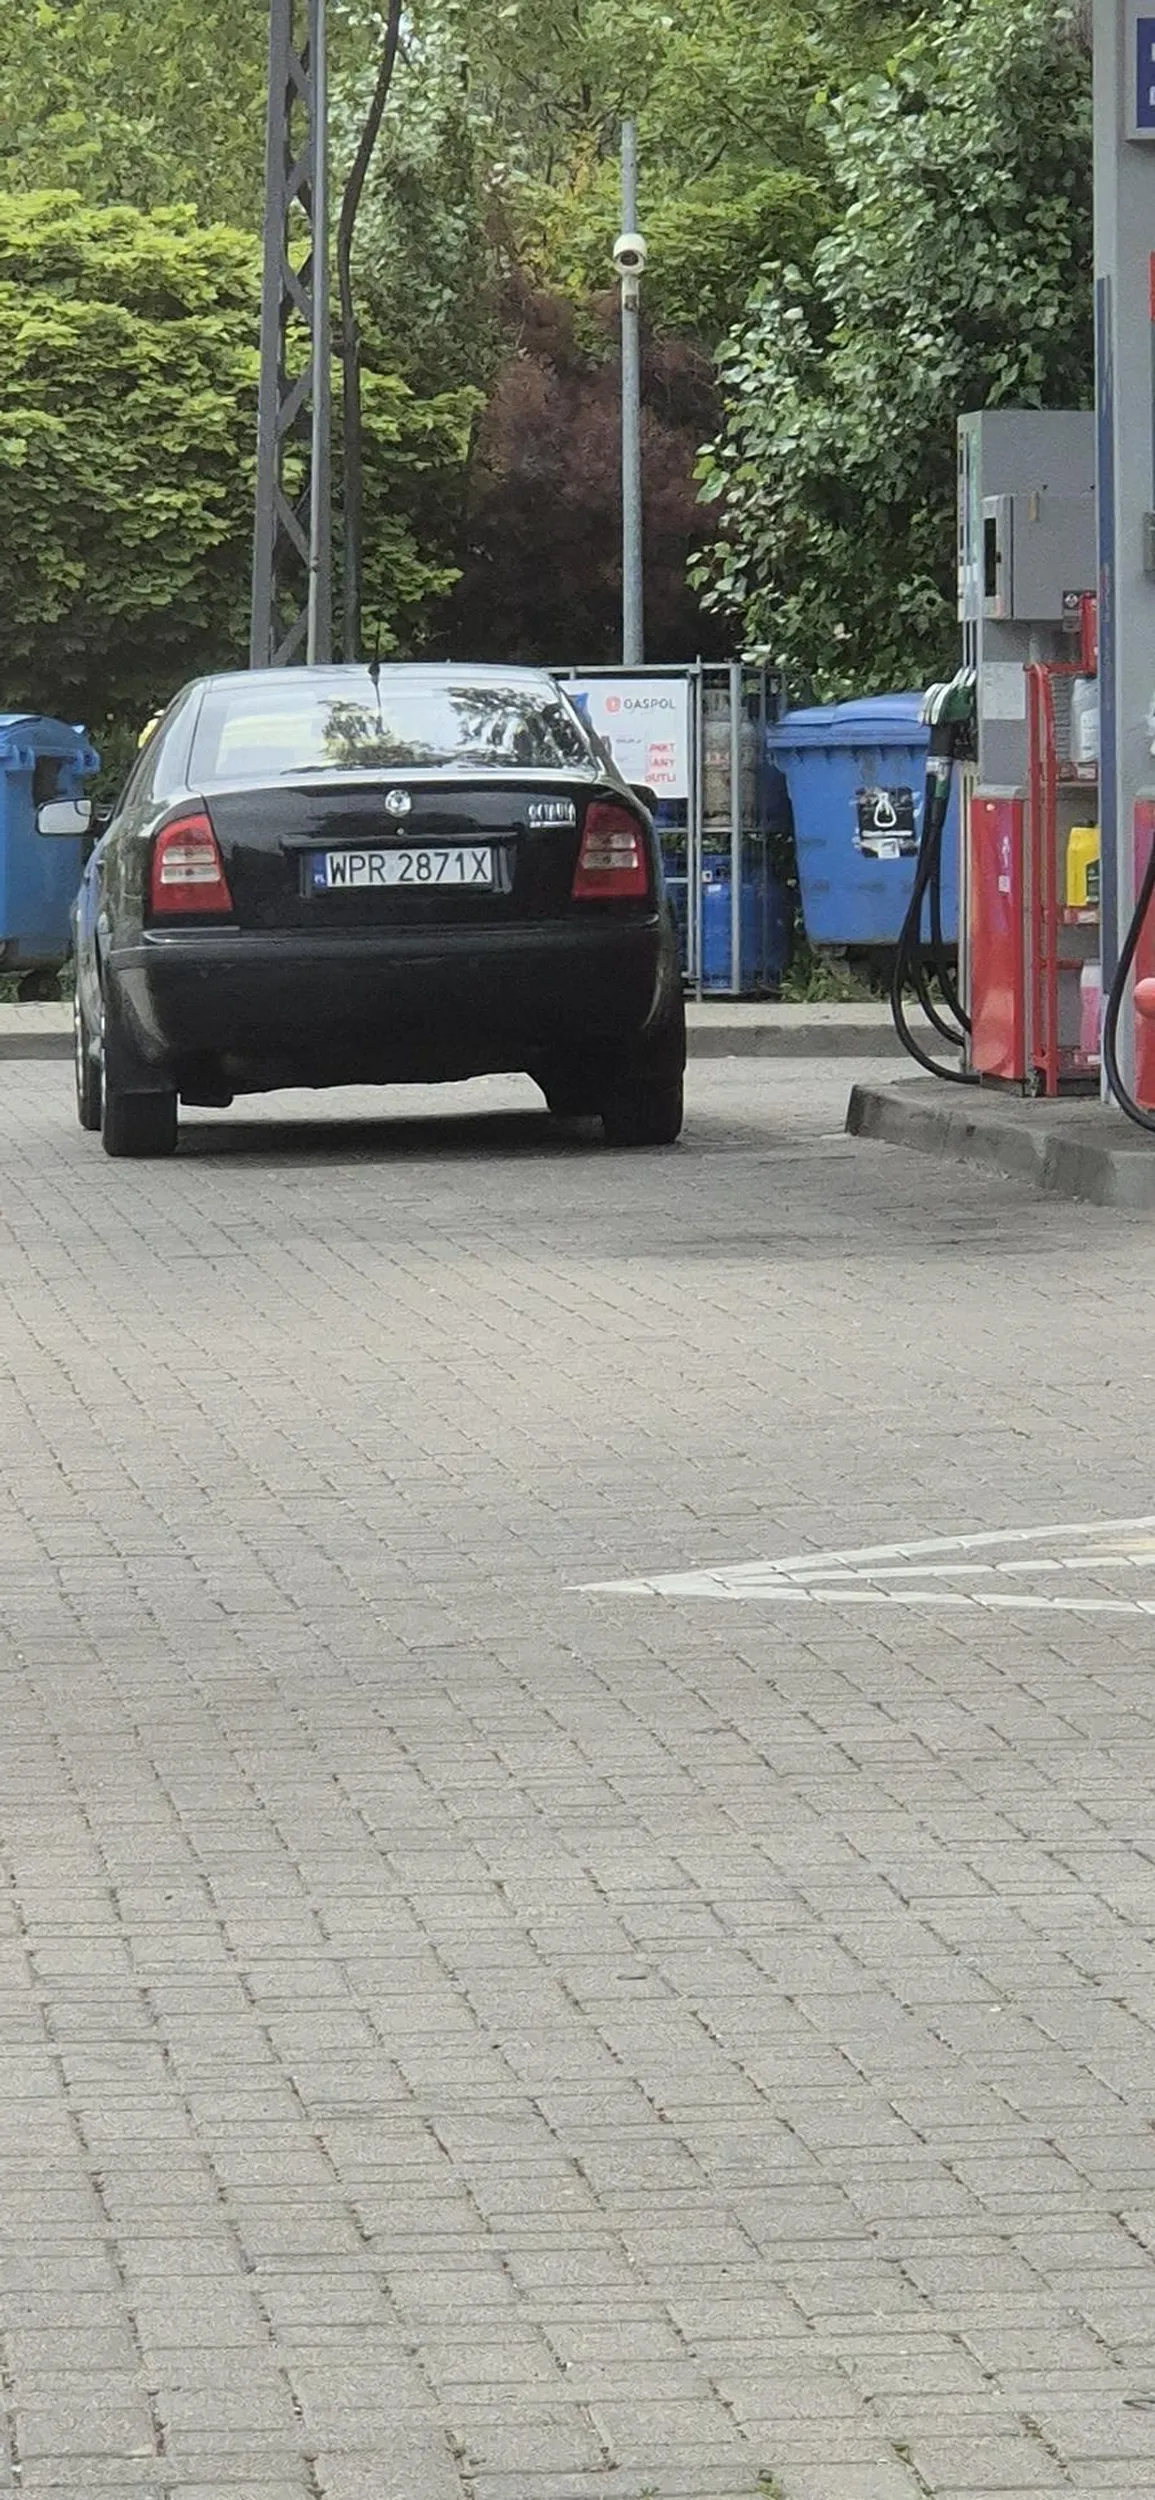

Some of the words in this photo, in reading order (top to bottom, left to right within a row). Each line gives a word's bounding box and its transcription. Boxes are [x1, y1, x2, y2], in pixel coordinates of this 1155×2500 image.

[624, 699, 676, 709] GASPOL
[330, 853, 386, 884] WPR
[398, 851, 488, 882] 2871X
